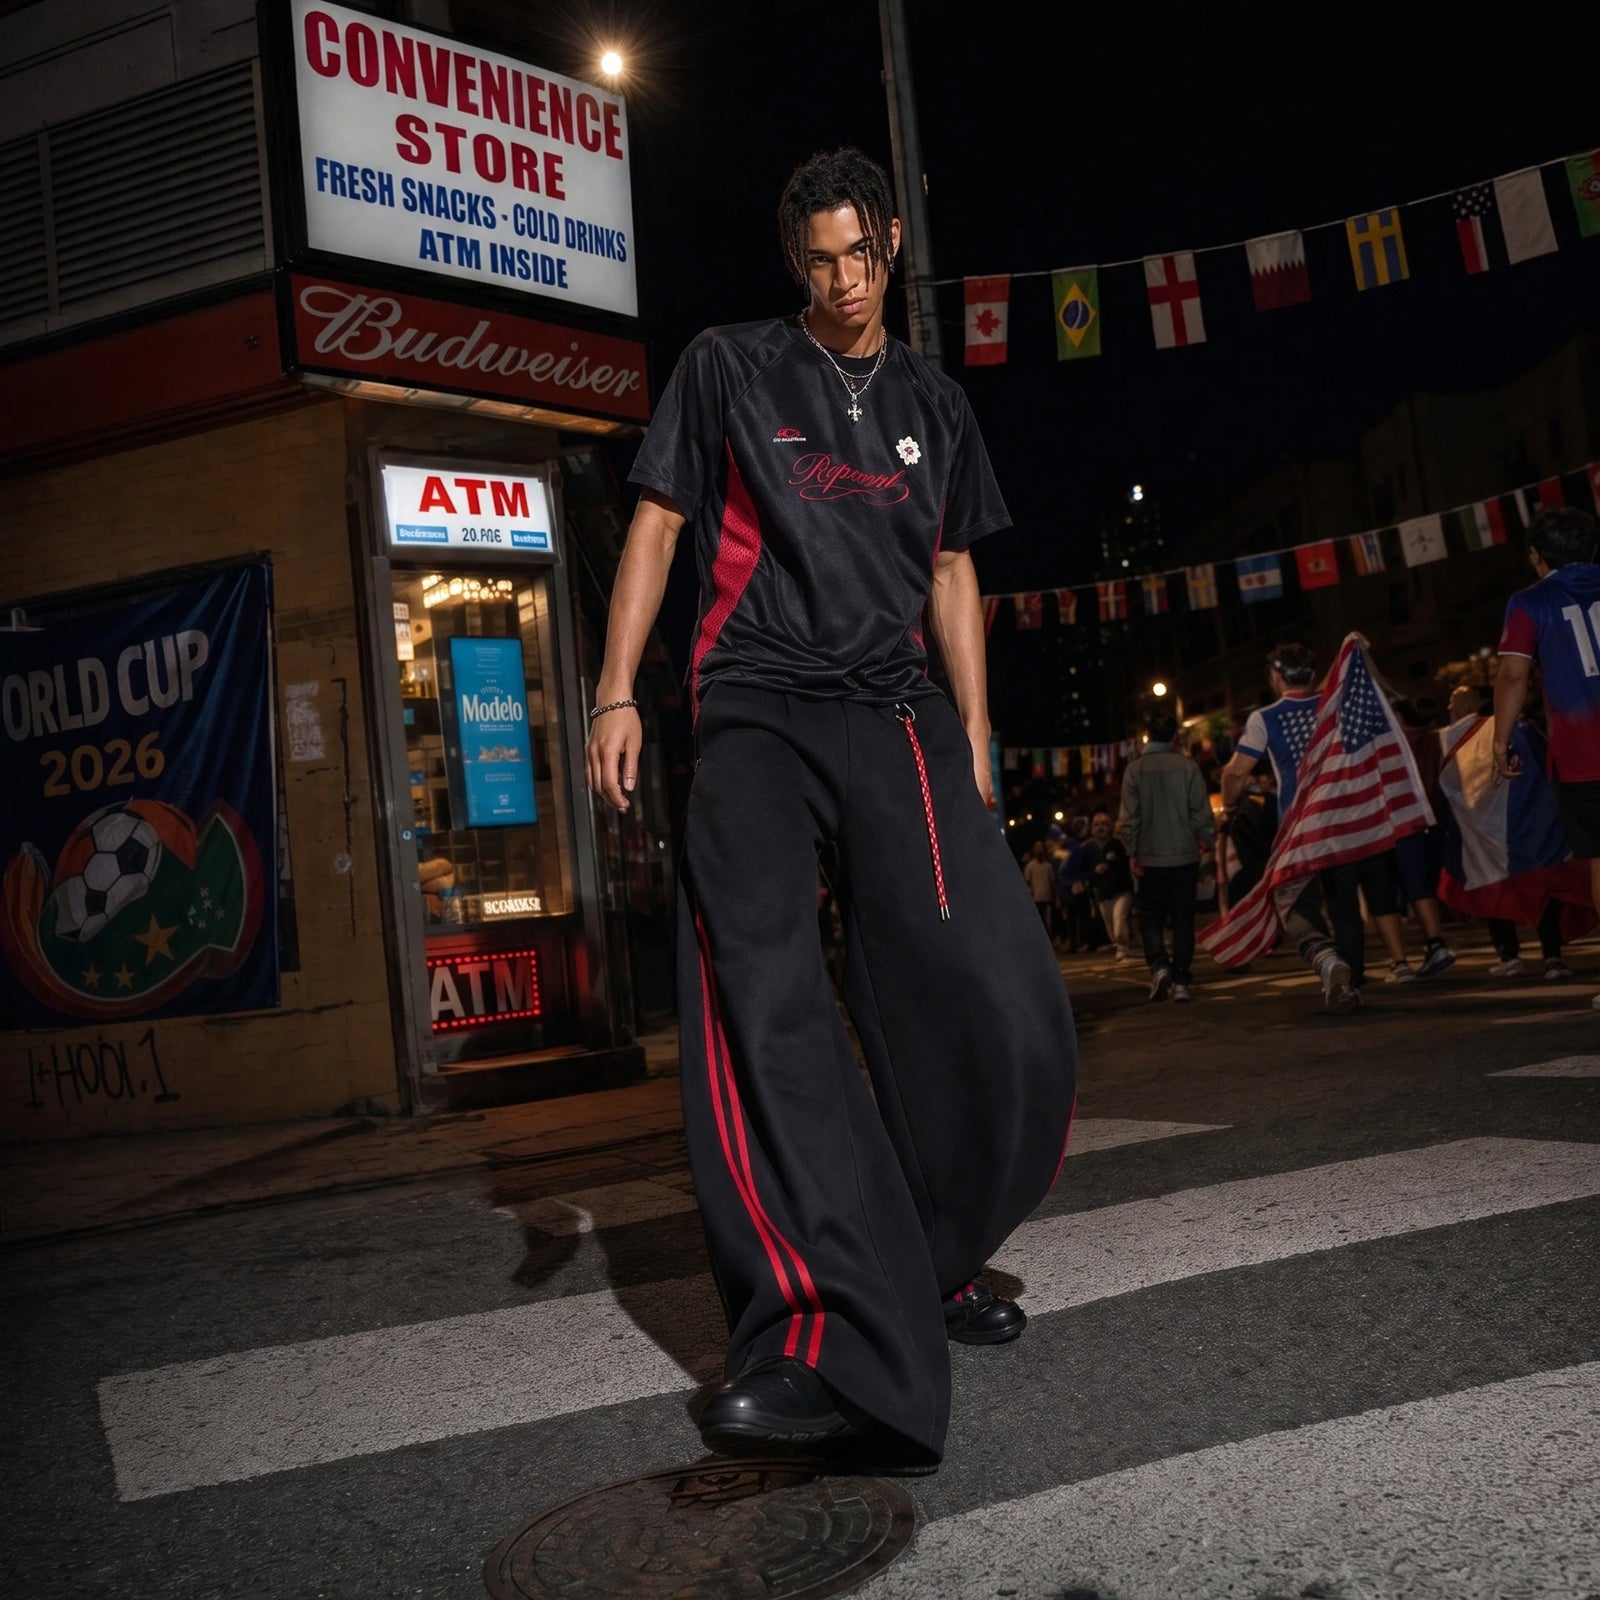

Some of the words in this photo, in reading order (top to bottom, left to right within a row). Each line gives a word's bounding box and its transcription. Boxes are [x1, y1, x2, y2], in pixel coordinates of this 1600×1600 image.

[304, 11, 624, 160] CONVENIENCE
[395, 114, 566, 201] STORE
[315, 156, 395, 207] FRESH
[402, 177, 497, 230] SNACKS
[513, 203, 560, 245] COLD
[565, 216, 627, 263] DRINKS
[419, 229, 481, 270] ATM
[489, 244, 568, 289] INSIDE
[300, 285, 640, 397] Budweiser
[419, 476, 530, 518] ATM
[0, 656, 110, 742] ORLD
[117, 629, 209, 717] CUP
[462, 694, 523, 724] Modelo
[39, 730, 165, 798] 2026
[430, 958, 534, 1021] ATM
